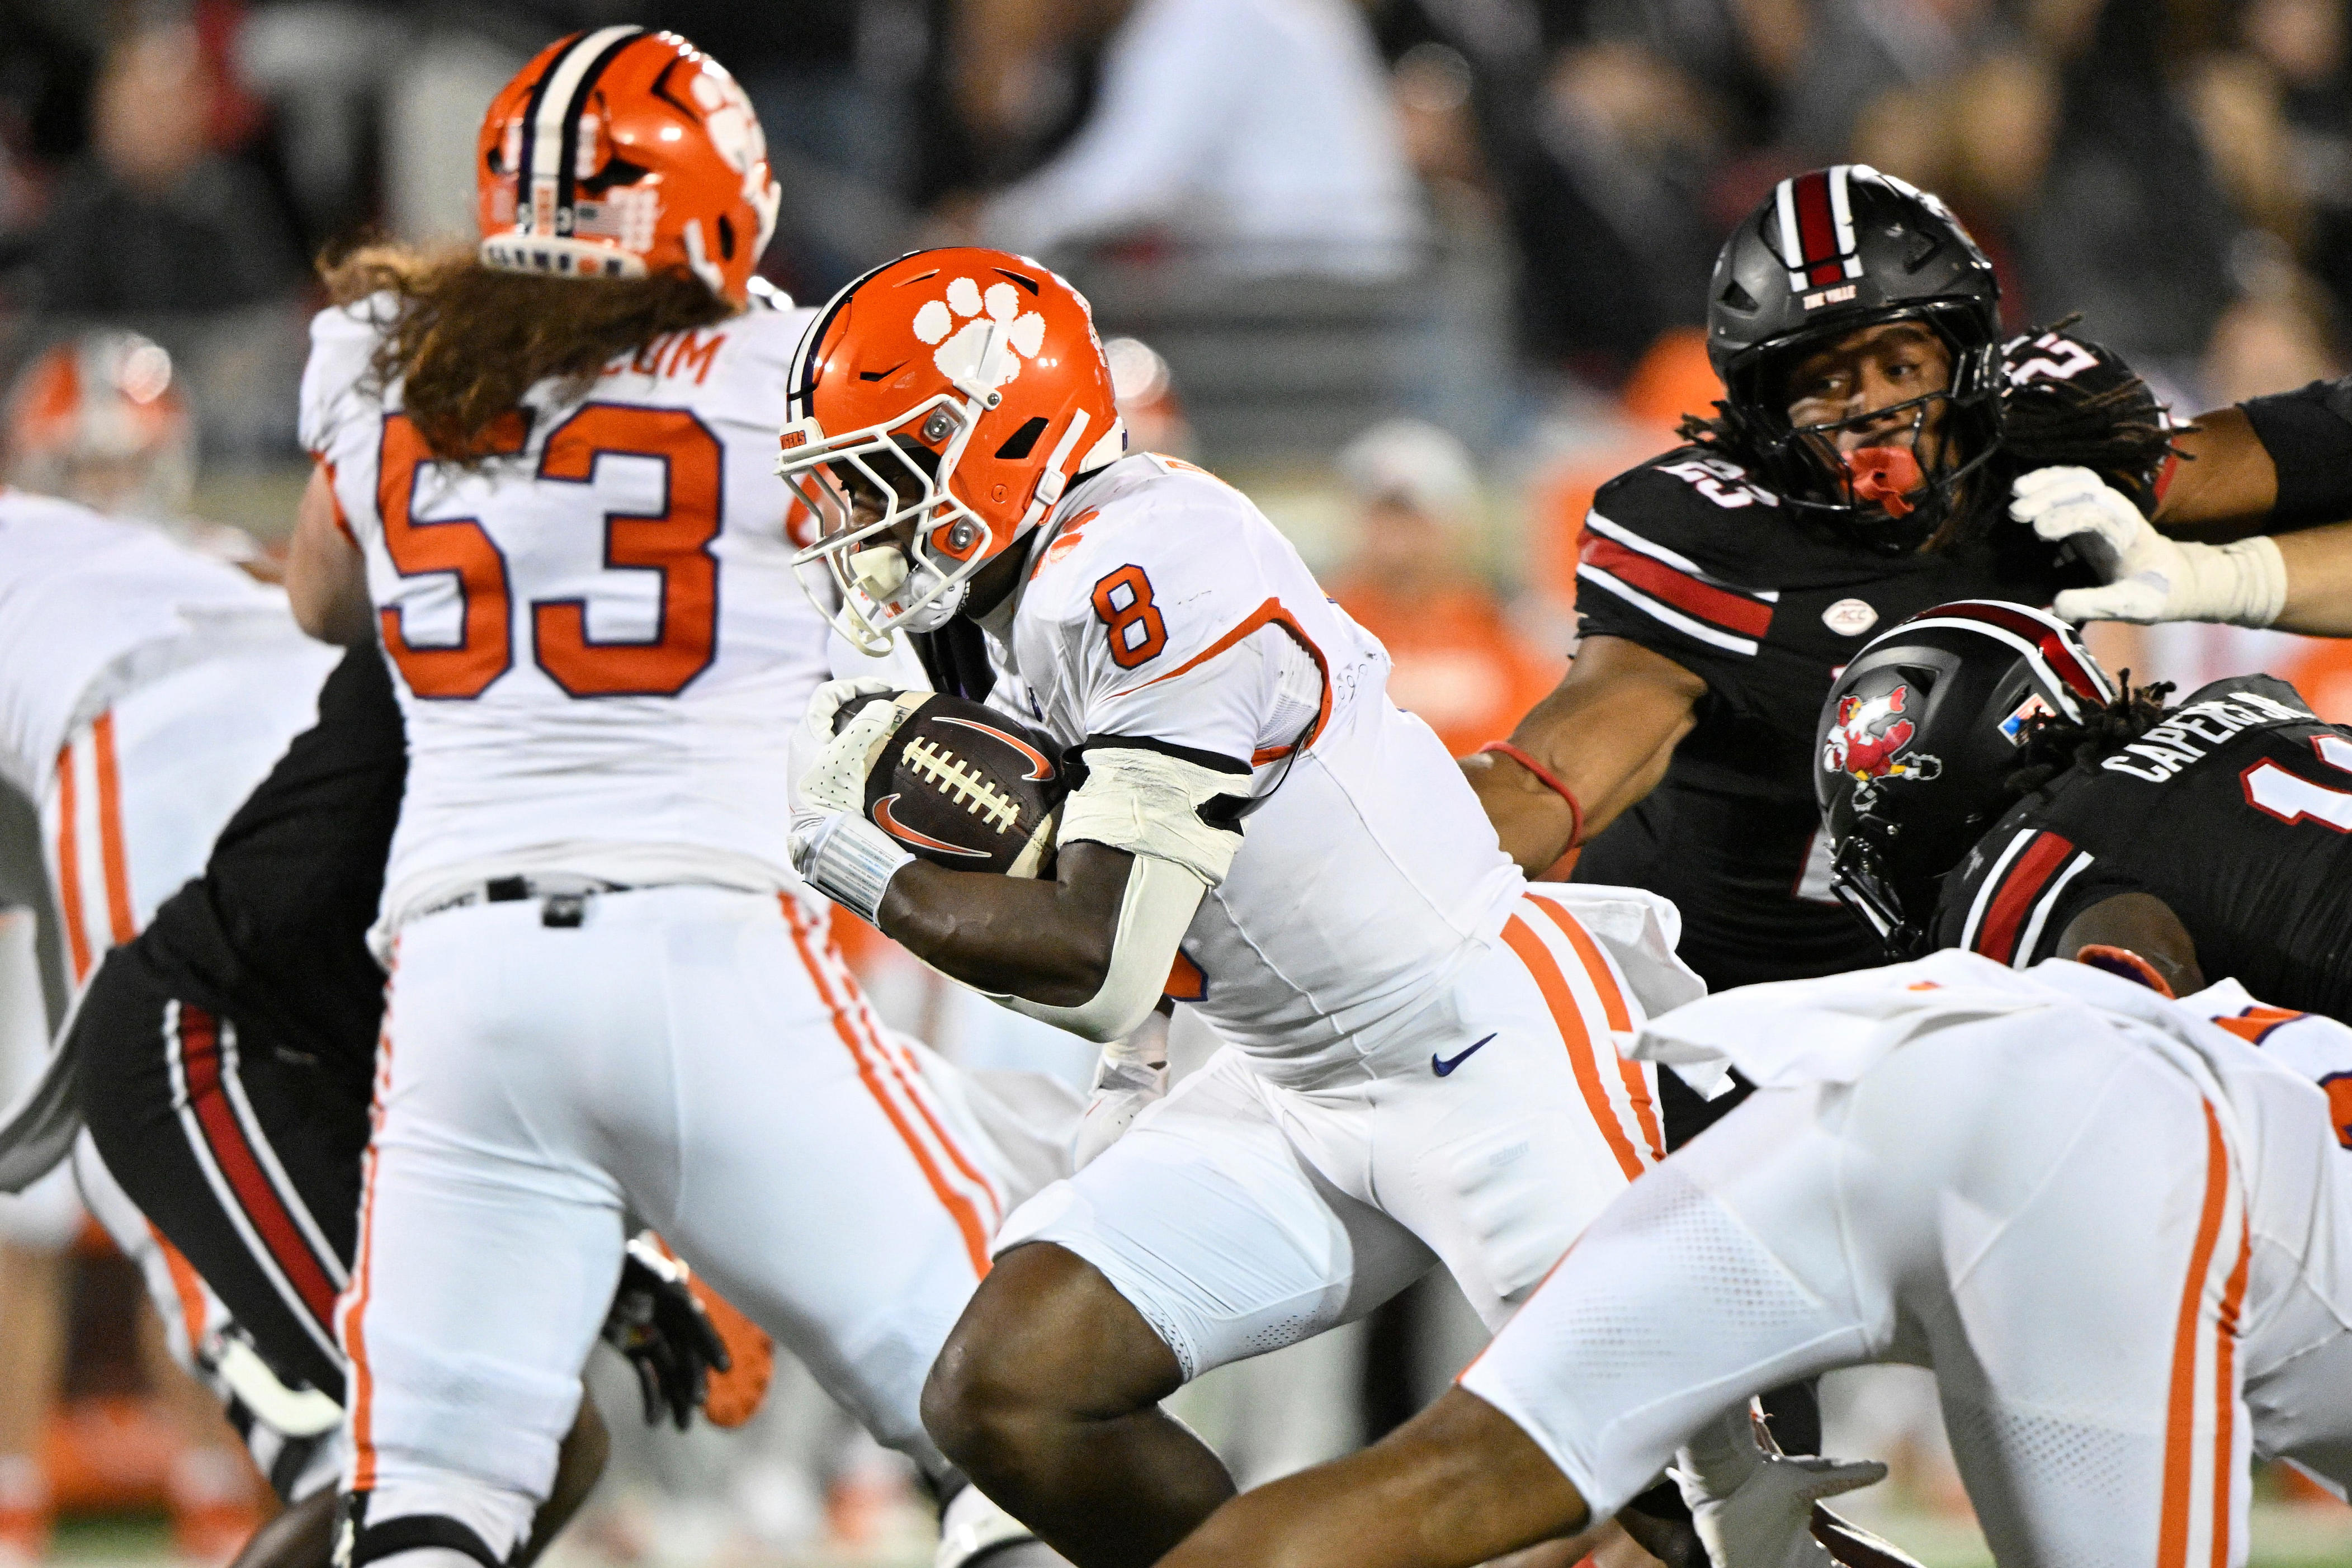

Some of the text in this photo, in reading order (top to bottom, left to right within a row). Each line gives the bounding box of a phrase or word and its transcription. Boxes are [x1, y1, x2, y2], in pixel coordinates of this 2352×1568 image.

[377, 402, 724, 700] 53
[1090, 563, 1169, 670] 8
[1835, 608, 1867, 621] ACC
